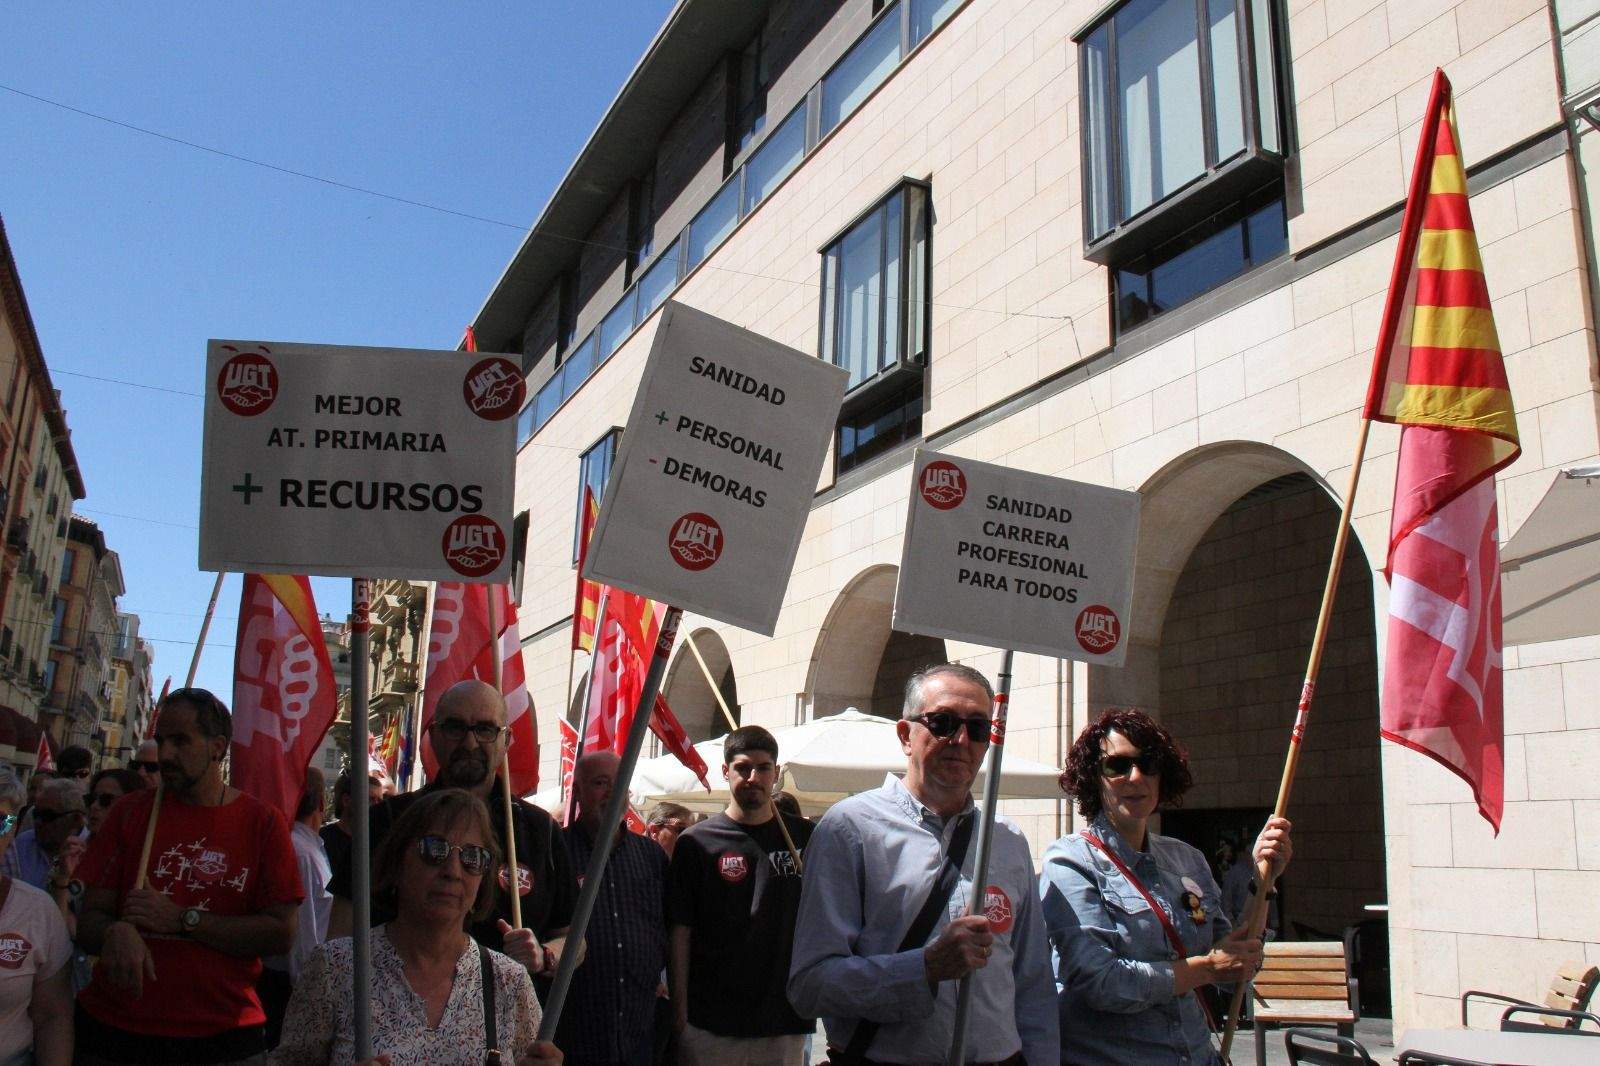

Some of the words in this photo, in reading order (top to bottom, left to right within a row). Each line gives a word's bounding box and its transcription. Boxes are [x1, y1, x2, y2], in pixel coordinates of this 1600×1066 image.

[225, 364, 272, 388] UGT
[468, 362, 511, 397] UGT
[689, 356, 786, 406] SANIDAD
[314, 394, 402, 417] MEJOR
[267, 428, 305, 449] AT.
[315, 429, 447, 453] PRIMARIA
[676, 415, 785, 471] PERSONAL
[663, 456, 767, 508] DEMORAS
[925, 468, 962, 489] UGT
[279, 478, 484, 513] RECURSOS
[986, 494, 1072, 524] SANIDAD
[449, 525, 498, 549] UGT
[678, 518, 719, 544] UGT
[982, 521, 1070, 550] CARRERA
[957, 541, 1088, 579] PROFESIONAL
[958, 568, 1008, 592] PARA
[1014, 578, 1078, 604] TODOS
[1081, 611, 1116, 632] UGT
[722, 856, 744, 870] UGT
